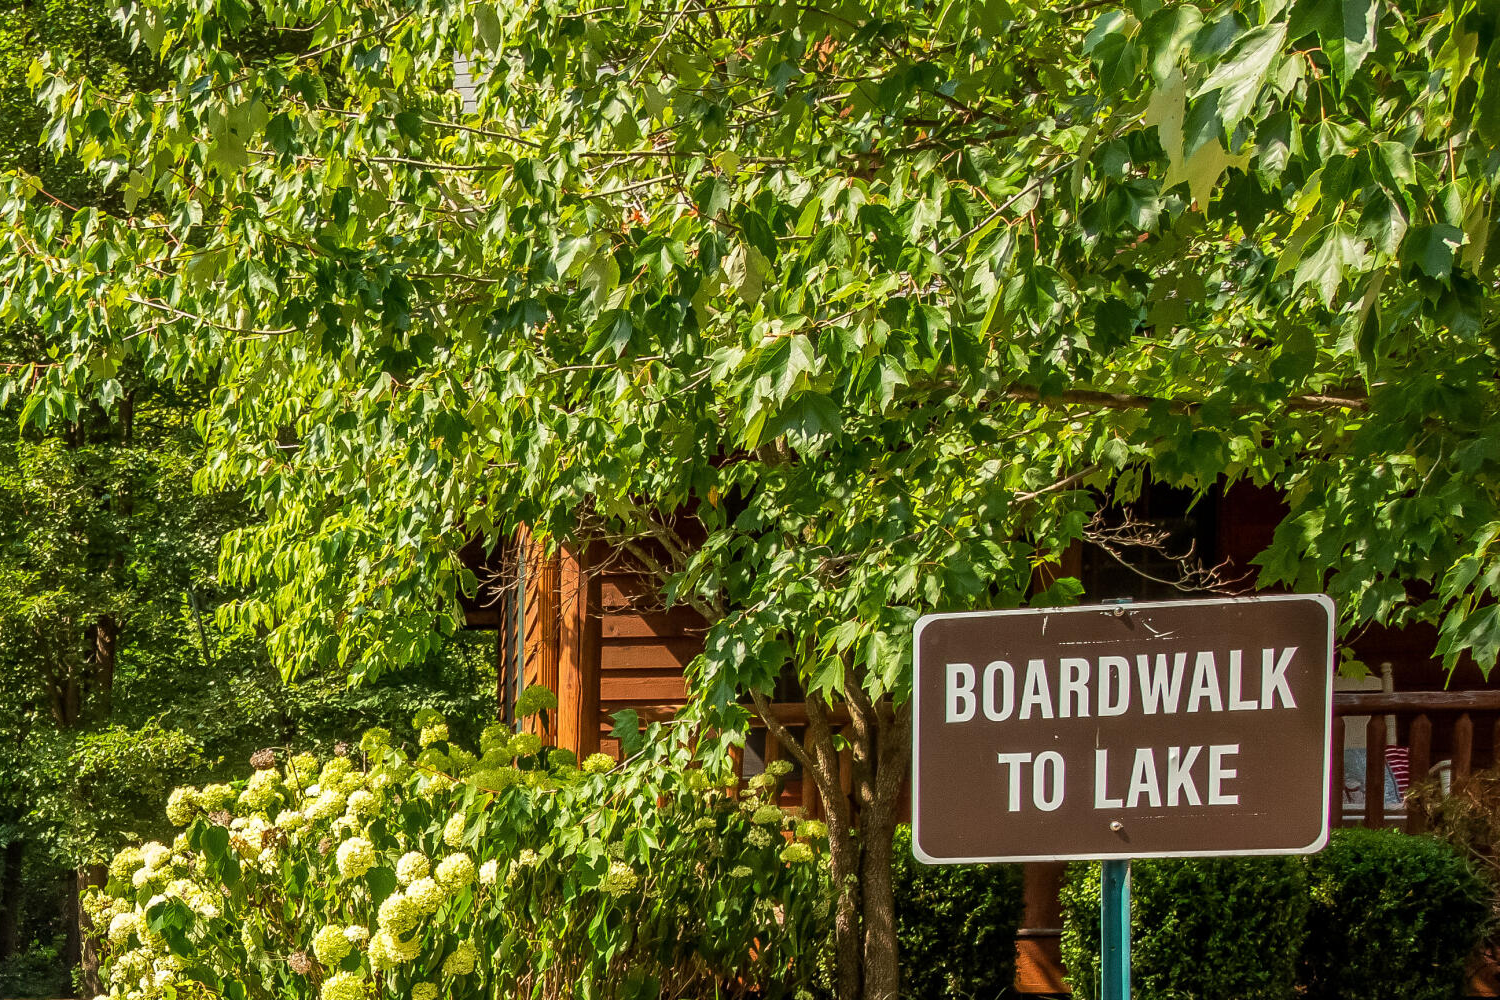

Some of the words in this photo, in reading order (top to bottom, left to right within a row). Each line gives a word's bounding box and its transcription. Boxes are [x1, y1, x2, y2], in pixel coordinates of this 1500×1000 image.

[945, 646, 1298, 723] BOARDWALK
[998, 751, 1066, 812] TO
[1094, 743, 1240, 809] LAKE
